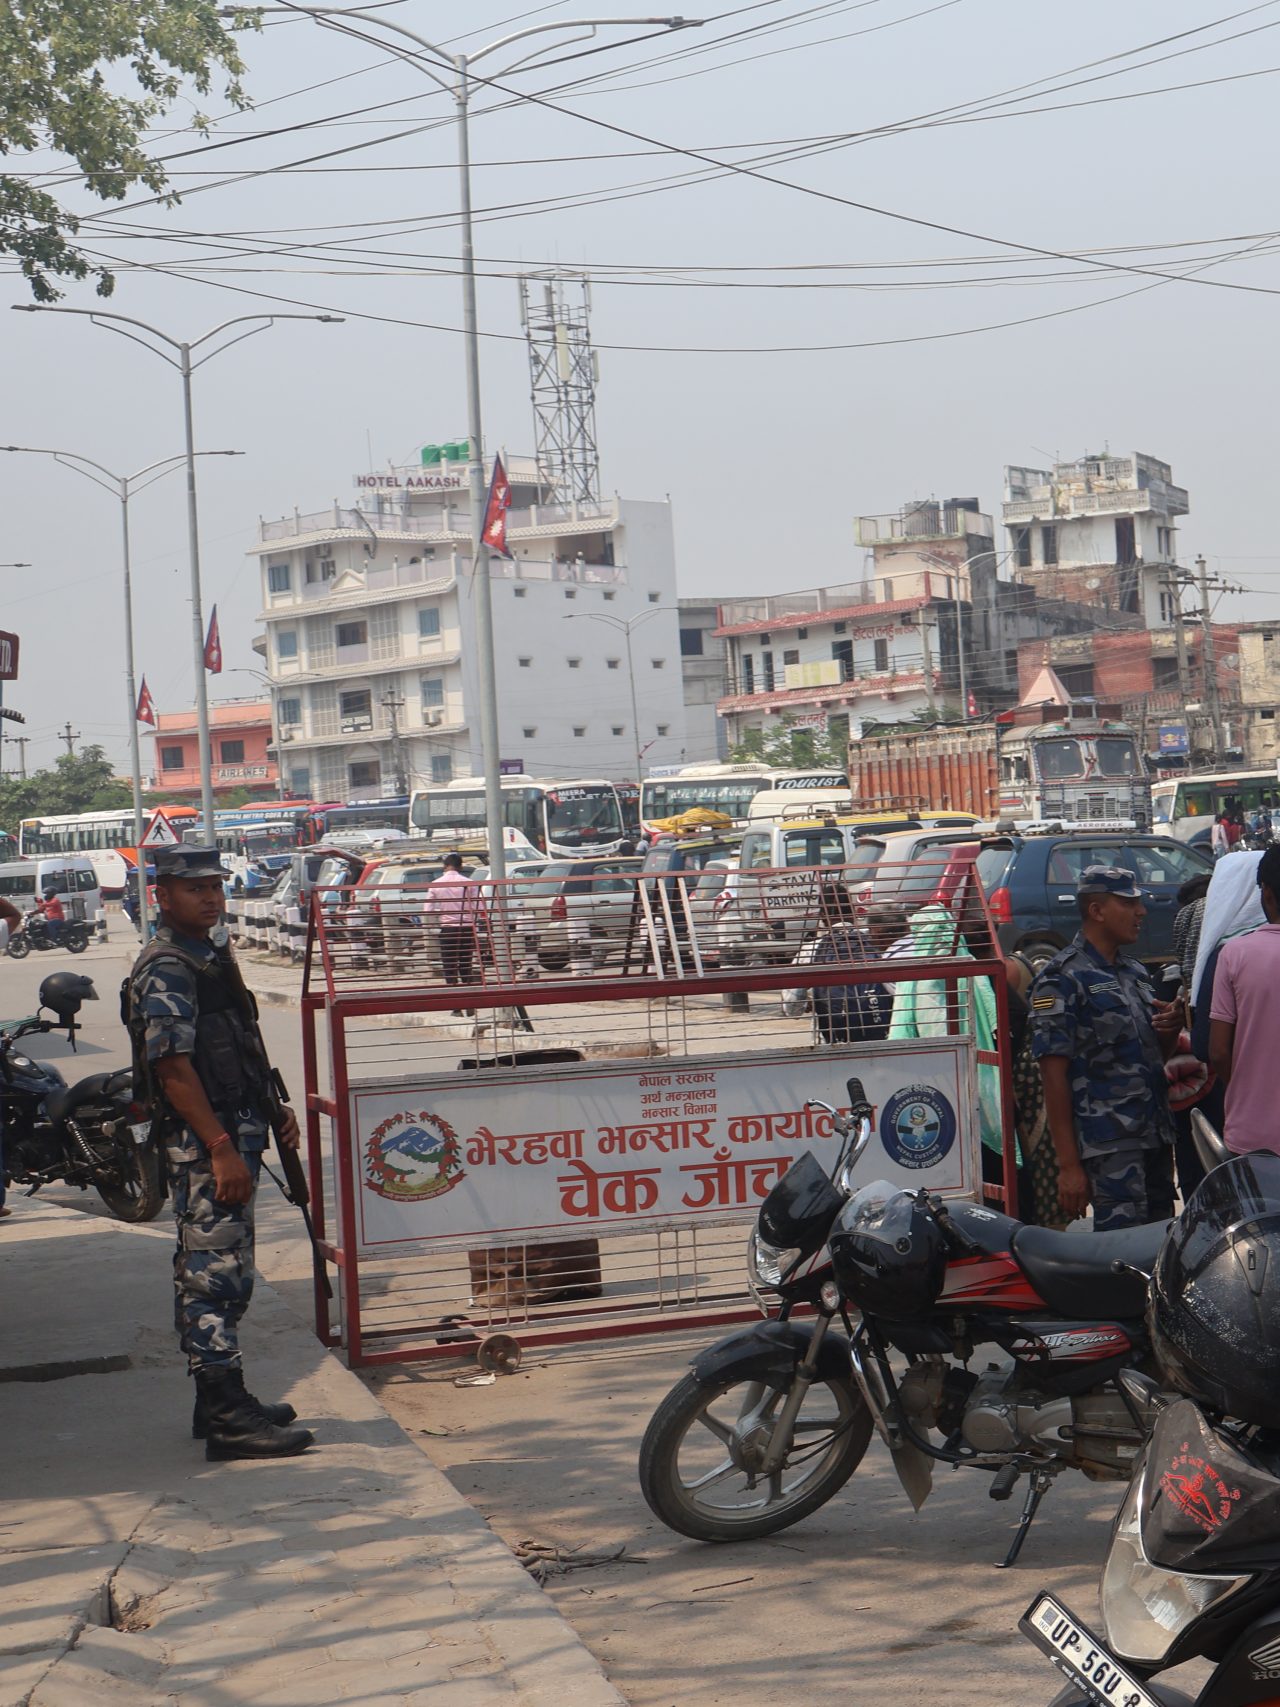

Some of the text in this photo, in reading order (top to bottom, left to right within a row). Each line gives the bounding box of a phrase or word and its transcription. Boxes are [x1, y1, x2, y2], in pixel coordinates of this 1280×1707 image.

[357, 475, 461, 488] HOTEL AAKASH
[777, 777, 844, 790] TOURIST
[557, 789, 586, 797] MEERA
[639, 1072, 716, 1087] नेपाल सरकार
[640, 1088, 716, 1104] अर्थ मन्त्रालय
[642, 1103, 717, 1119] भन्सार विभाग
[466, 1126, 585, 1166] भैरहवा
[597, 1118, 717, 1155] भन्सार
[557, 1159, 661, 1218] चेक
[1052, 1619, 1080, 1651] UP
[1081, 1650, 1122, 1695] 56U
